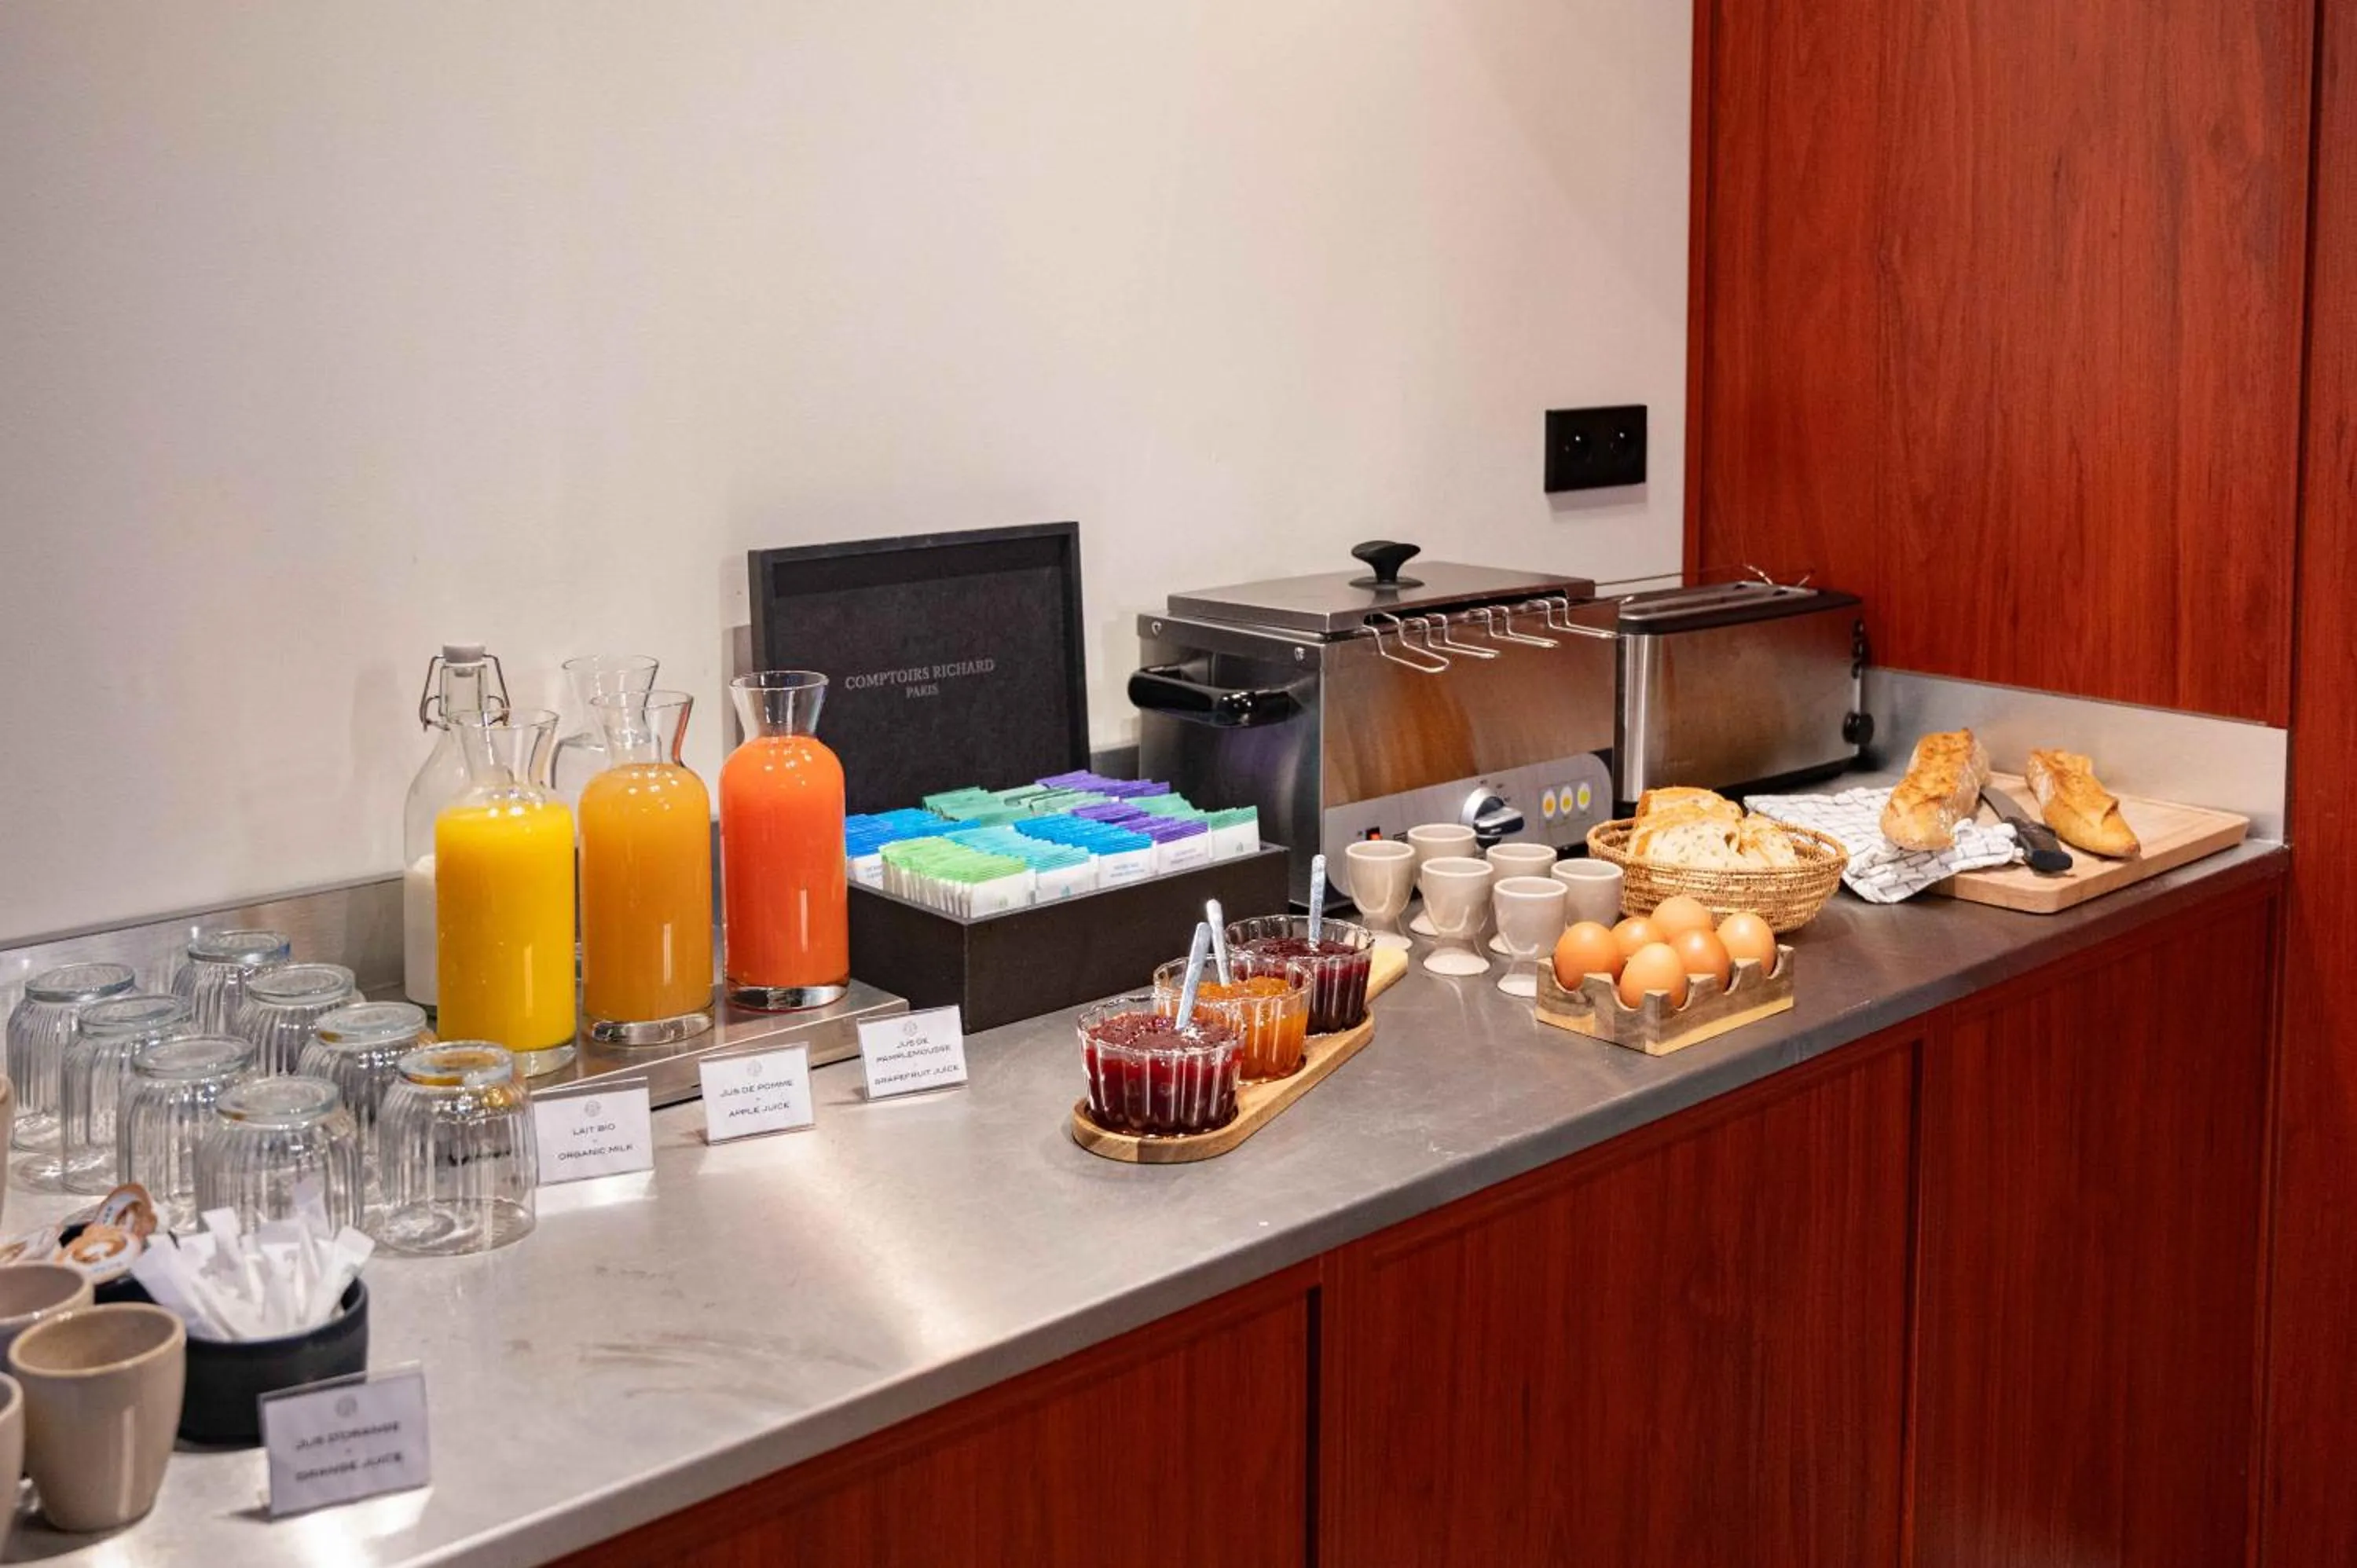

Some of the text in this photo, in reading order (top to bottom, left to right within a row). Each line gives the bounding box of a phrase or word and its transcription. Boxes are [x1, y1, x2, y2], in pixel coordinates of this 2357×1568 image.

[845, 658, 995, 690] COMPTOIRS RICHARD
[905, 683, 939, 698] PARIS
[742, 1085, 755, 1094] DE
[757, 1079, 794, 1092] POMME
[728, 1105, 761, 1118] APPLE
[573, 1123, 616, 1137] LAIT BIO
[558, 1144, 633, 1161] ORGANIC MILK
